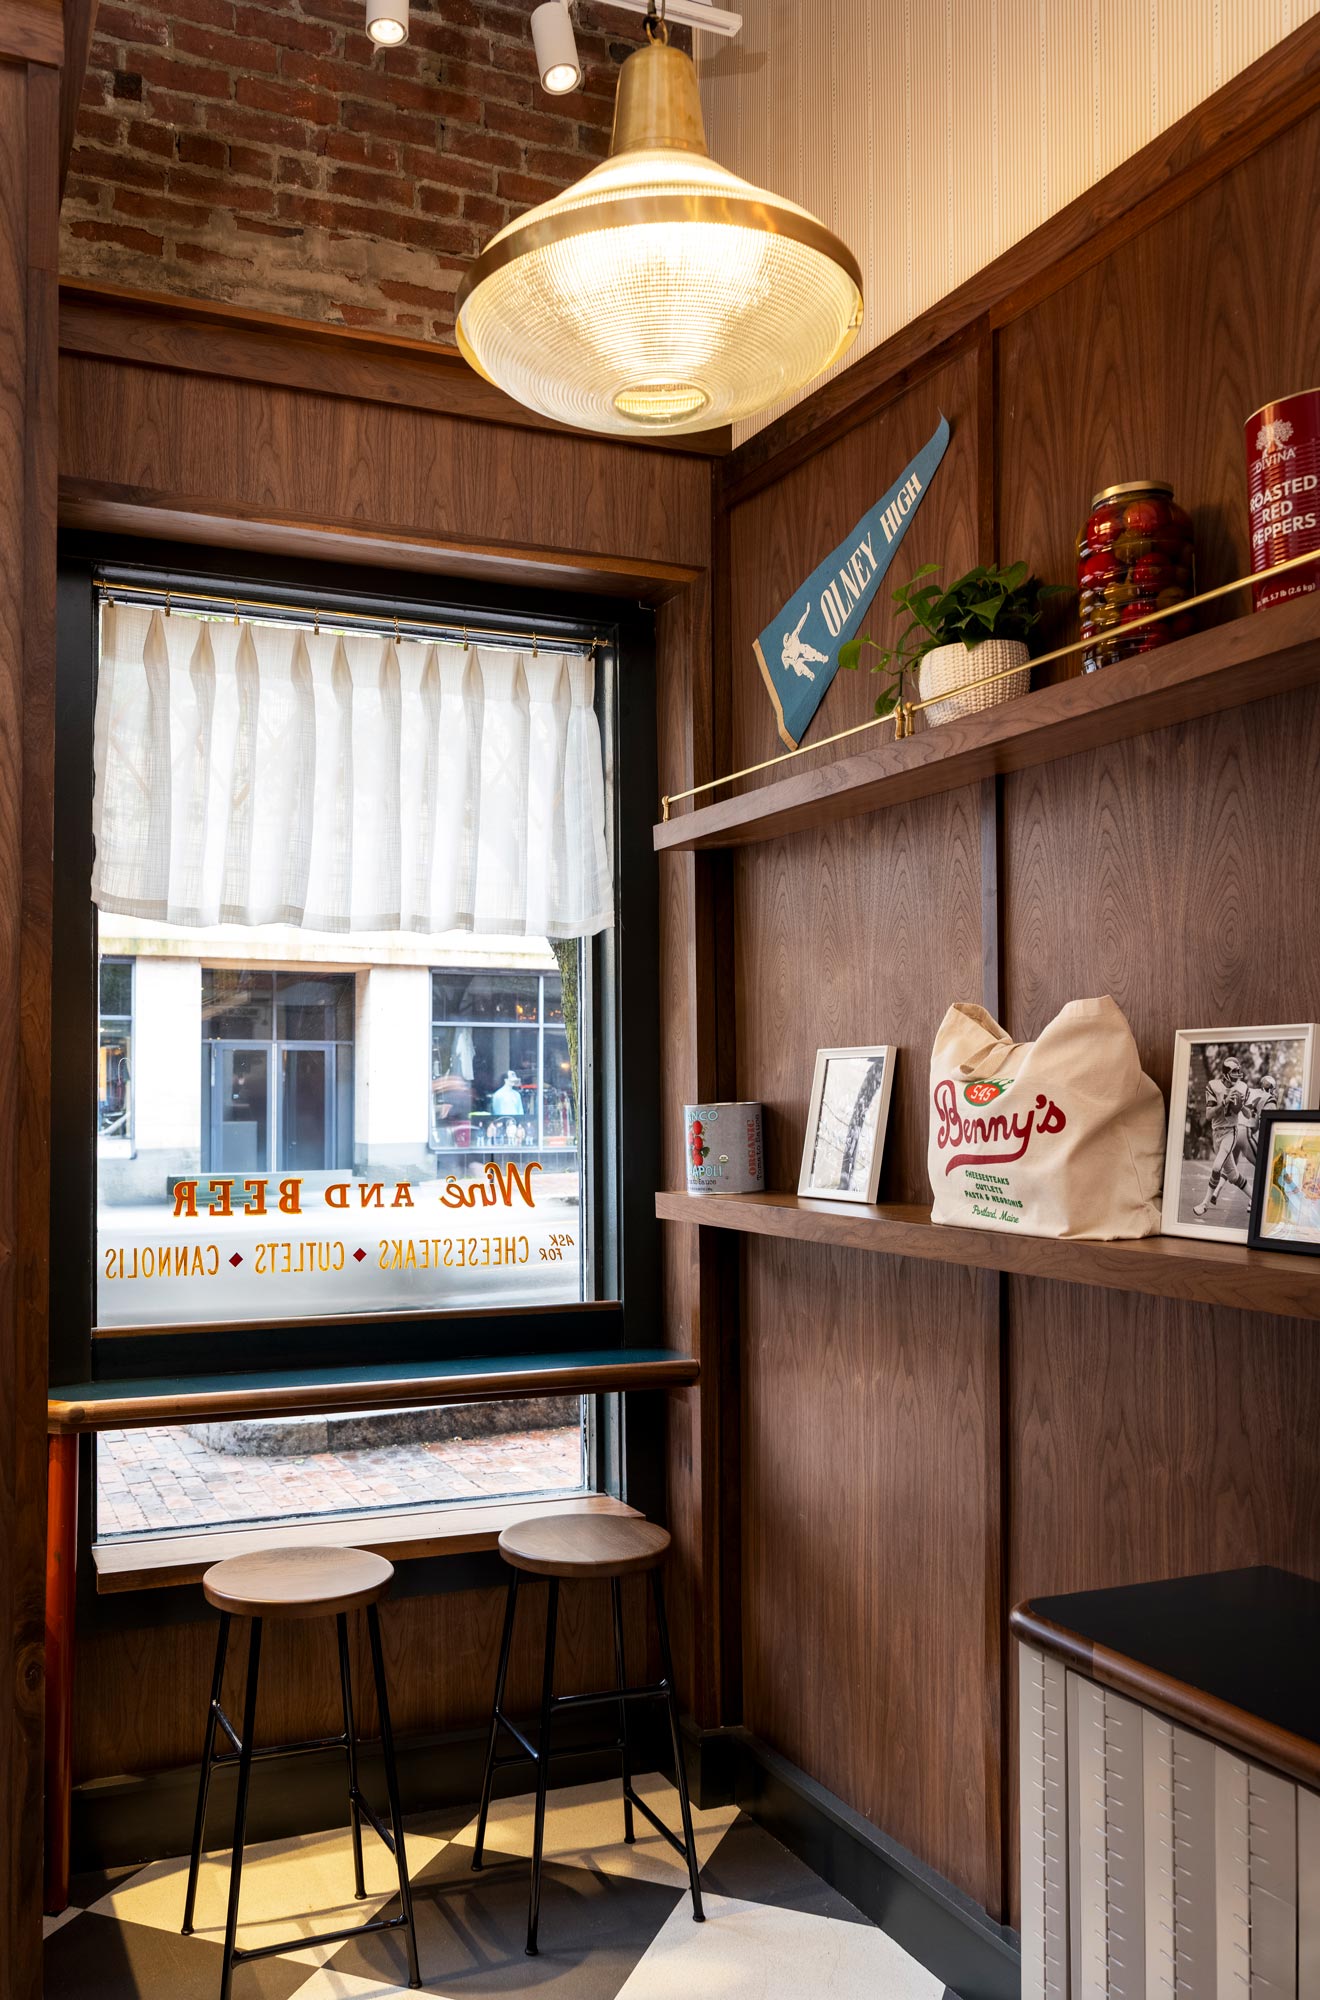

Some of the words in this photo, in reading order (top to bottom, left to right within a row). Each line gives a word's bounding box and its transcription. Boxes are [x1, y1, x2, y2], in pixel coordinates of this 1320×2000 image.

[1255, 448, 1296, 474] DIVINA
[1250, 474, 1318, 513] ROASTED
[1262, 500, 1293, 524] RED
[1252, 512, 1317, 549] PEPPERS
[820, 531, 878, 638] OLNEY
[879, 472, 923, 545] HIGH
[1270, 592, 1279, 601] 5.7
[1280, 590, 1287, 598] lb
[1288, 585, 1302, 596] (2.6
[1303, 582, 1316, 592] kg)
[970, 1084, 996, 1101] 545
[934, 1079, 1067, 1176] Benny's
[747, 1119, 756, 1177] ORGANIC
[965, 1170, 1010, 1186] CHEESESTEAKS
[975, 1183, 1003, 1195] CUTLETS
[964, 1190, 985, 1200] PASTA
[991, 1195, 1024, 1208] NEGRONIS
[999, 1210, 1020, 1223] Maine
